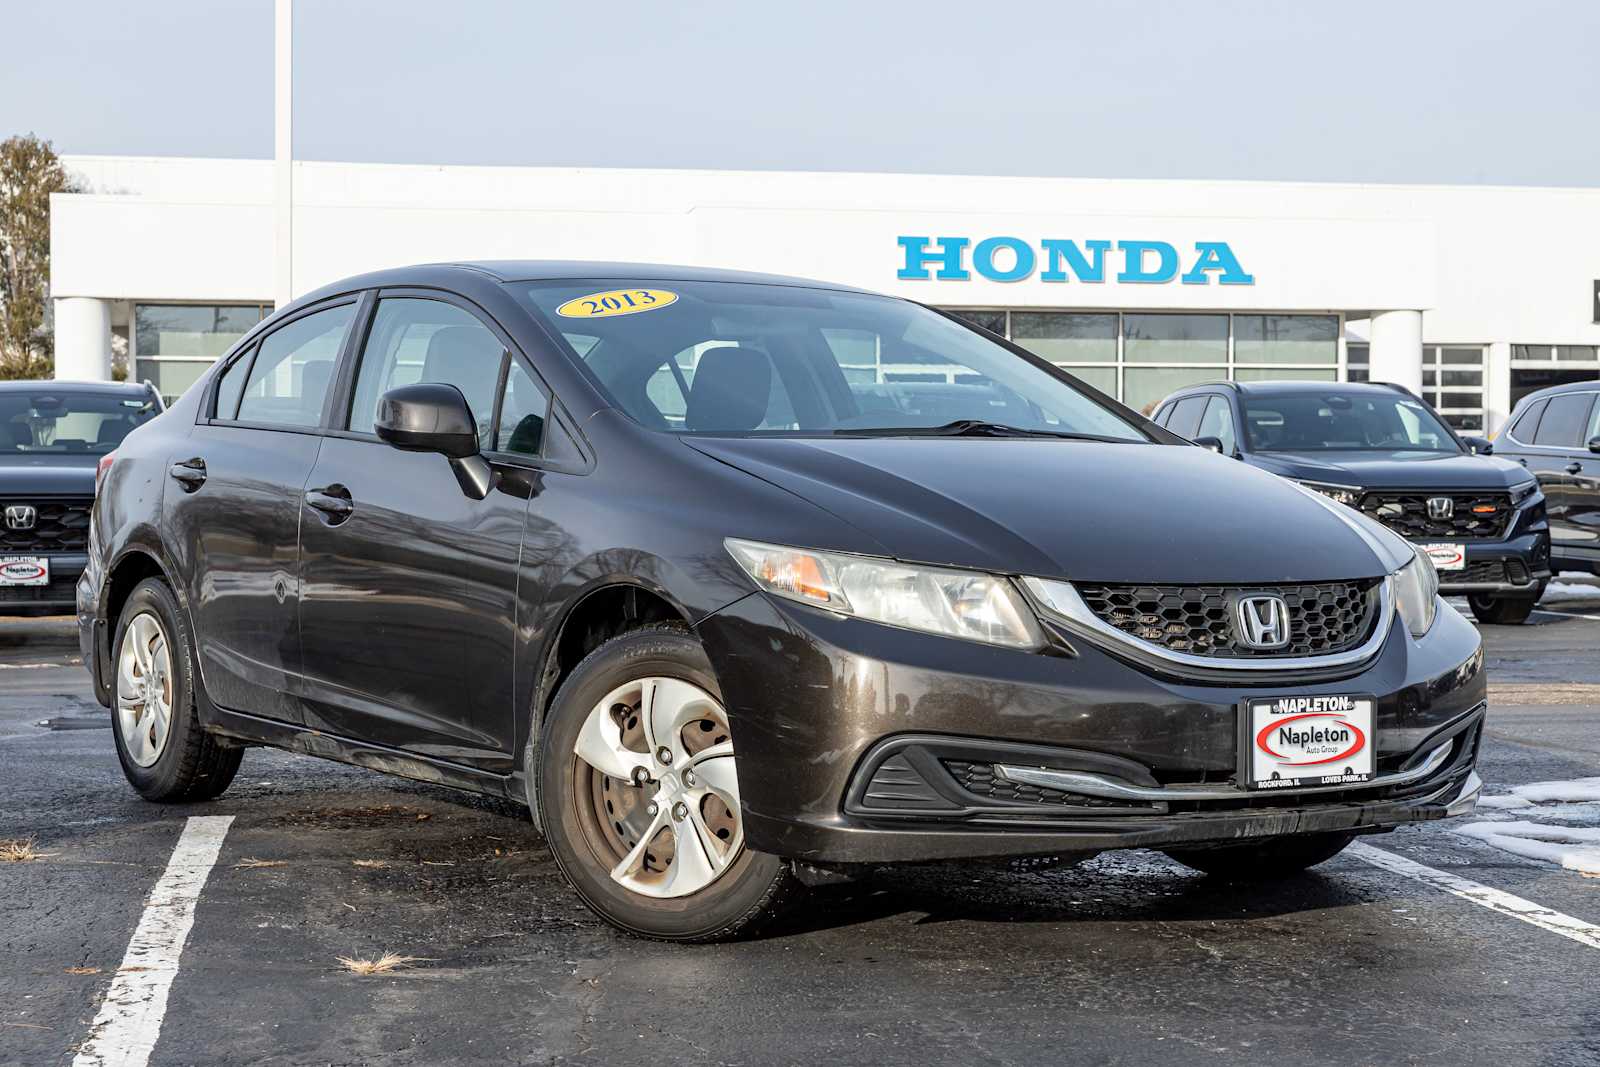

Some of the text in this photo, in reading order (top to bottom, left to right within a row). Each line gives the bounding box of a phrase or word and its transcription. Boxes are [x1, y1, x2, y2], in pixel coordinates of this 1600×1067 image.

[897, 236, 1255, 285] HONDA
[581, 291, 656, 315] 2013
[1279, 697, 1348, 713] NAPLETON
[1280, 726, 1349, 748] Napleton
[1321, 745, 1338, 753] Group
[1293, 778, 1301, 786] IL
[1321, 775, 1342, 784] LOVES
